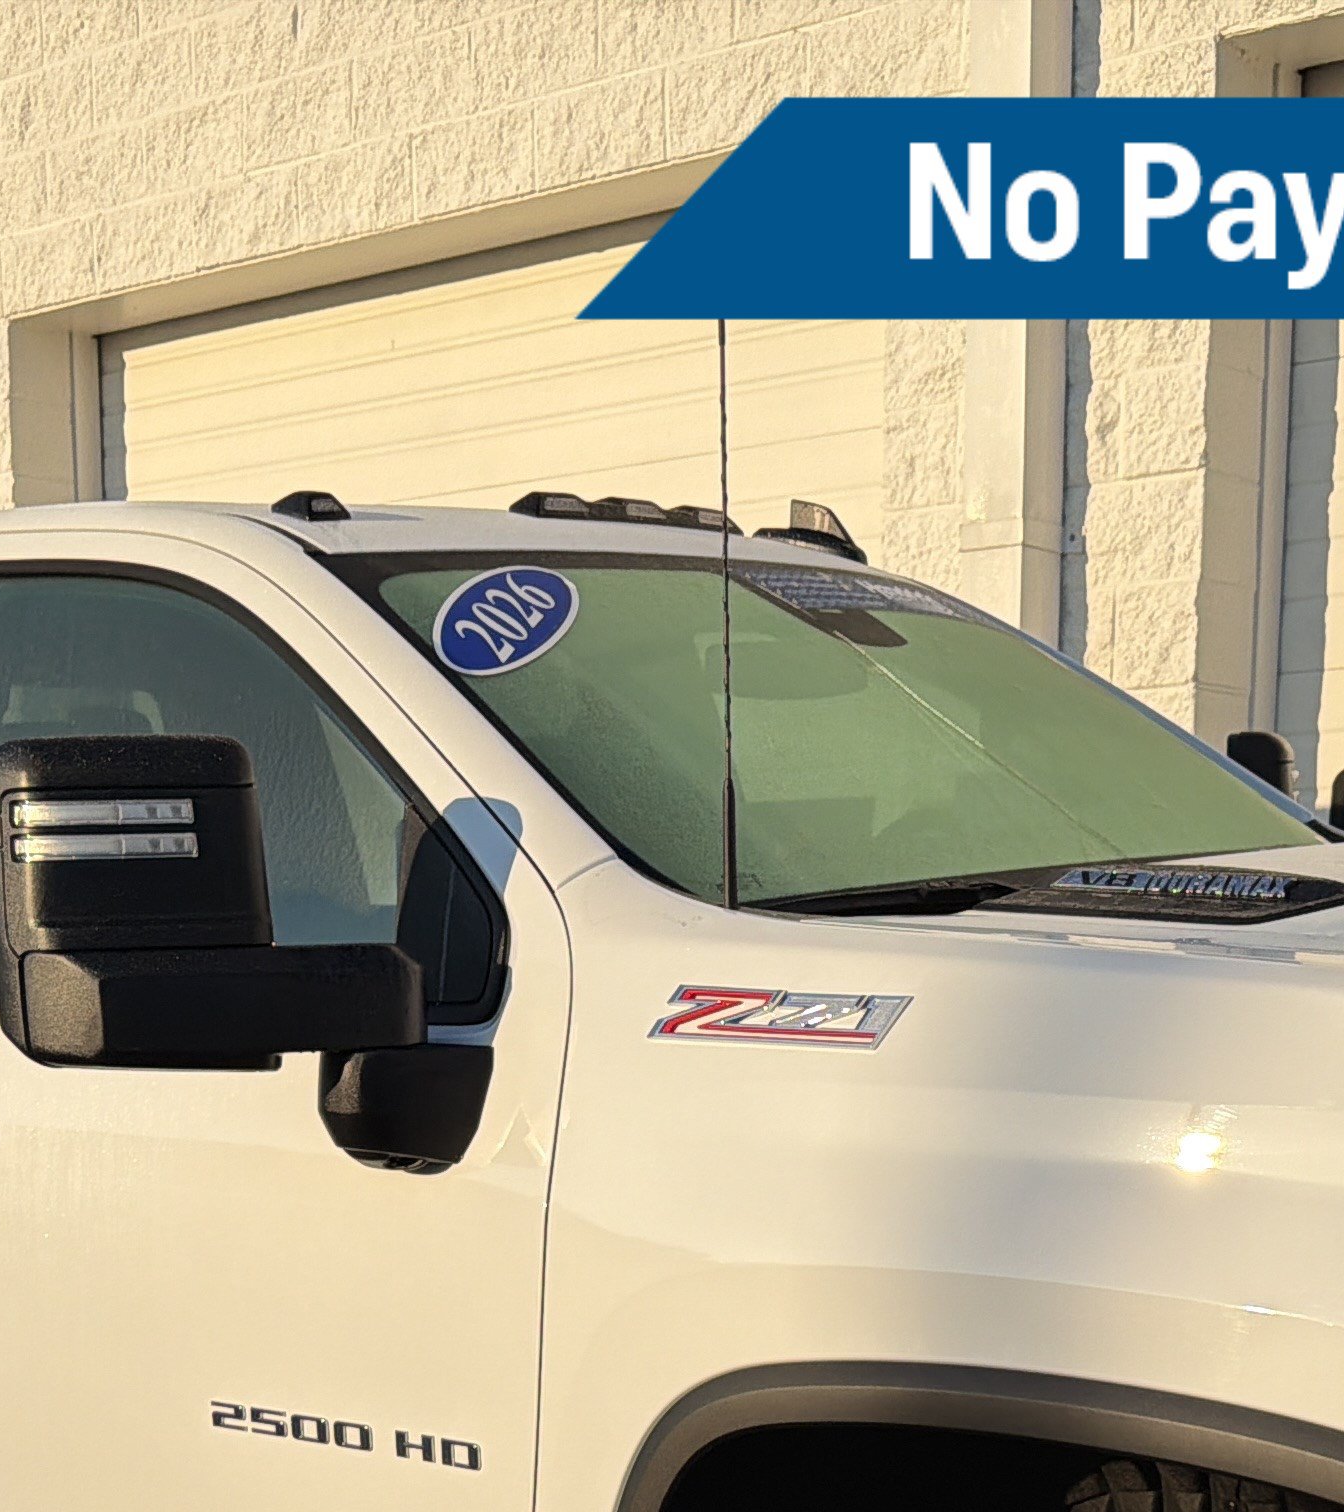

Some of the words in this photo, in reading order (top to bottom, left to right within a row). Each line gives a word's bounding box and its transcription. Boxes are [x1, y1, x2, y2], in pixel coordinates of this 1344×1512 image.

[455, 572, 556, 664] 2026
[647, 984, 914, 1050] Z71
[210, 1400, 374, 1453] 2500
[395, 1429, 483, 1472] HD
